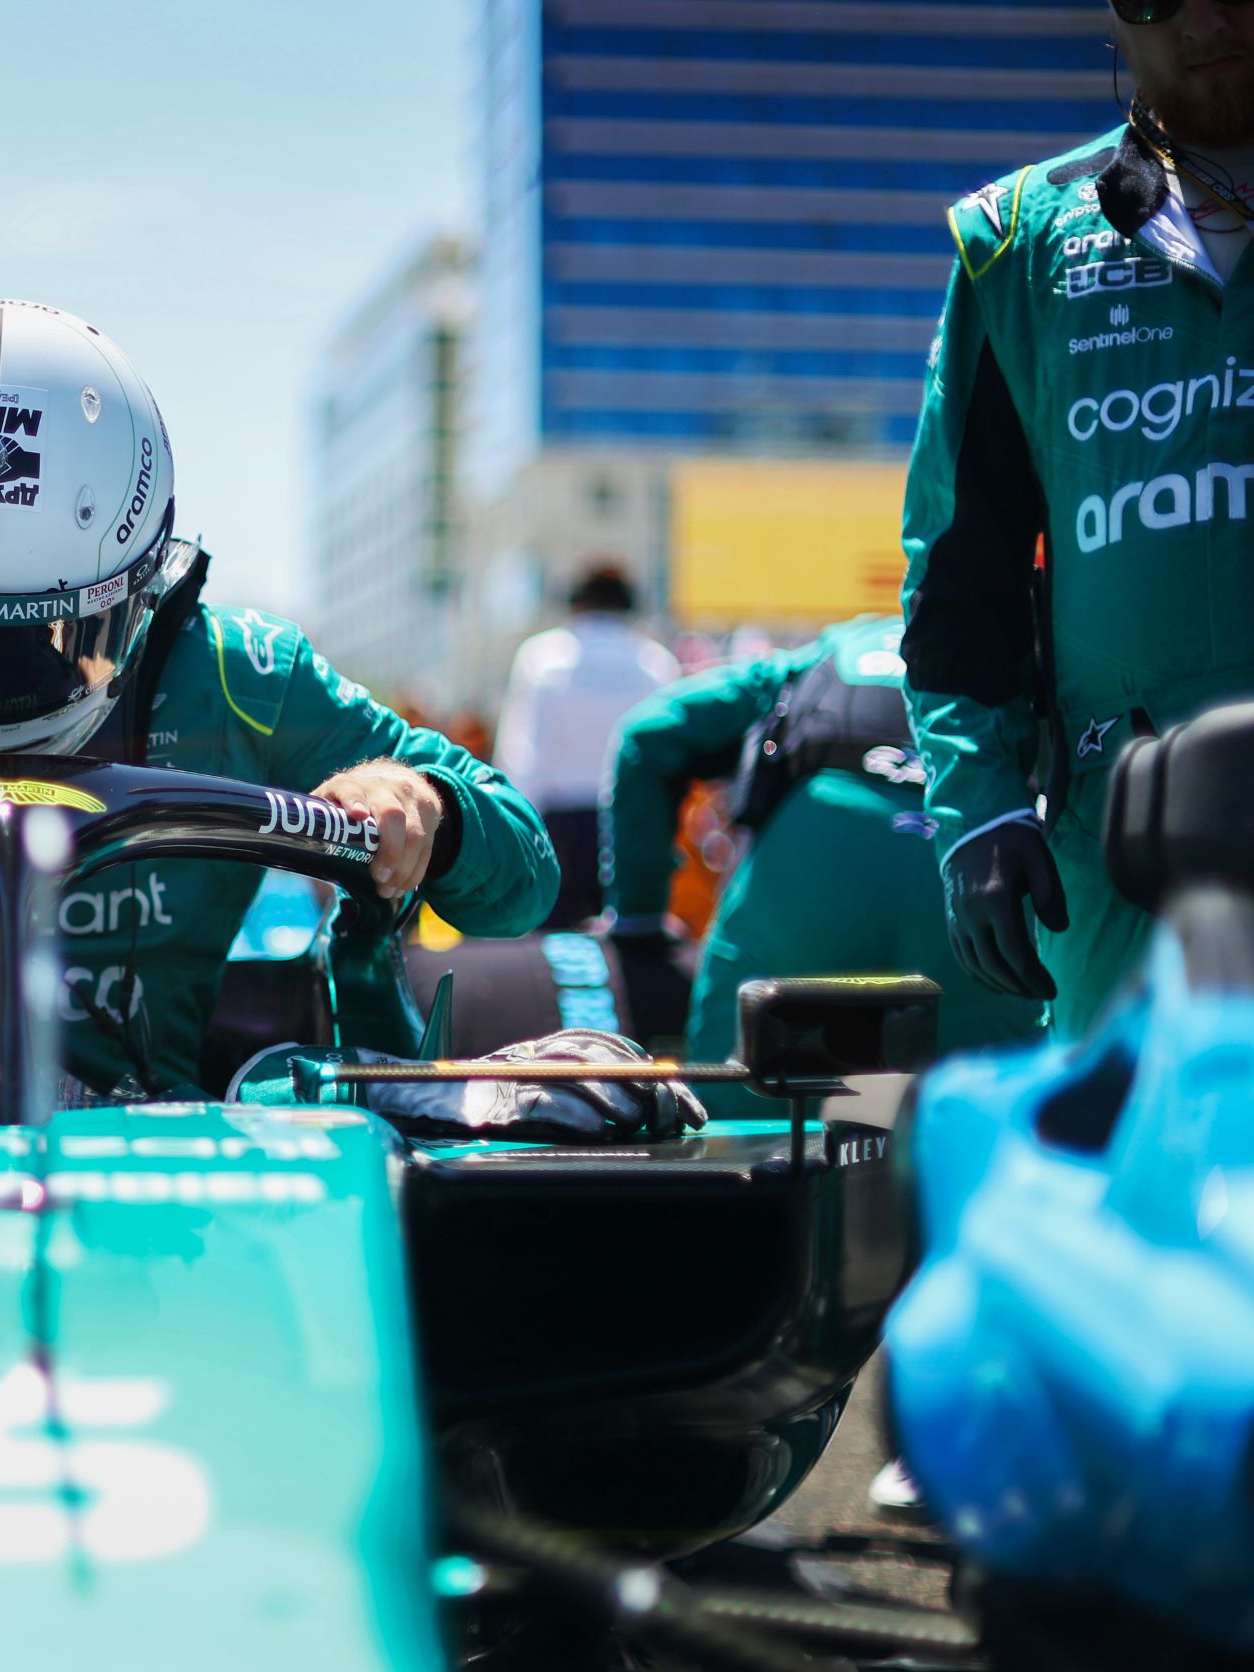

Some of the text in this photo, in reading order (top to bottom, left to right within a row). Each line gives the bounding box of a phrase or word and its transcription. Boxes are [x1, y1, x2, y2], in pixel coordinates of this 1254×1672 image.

[1067, 261, 1172, 298] JCB
[1068, 326, 1174, 355] SentinelOne
[116, 436, 153, 545] aramco
[87, 576, 123, 600] PERONI
